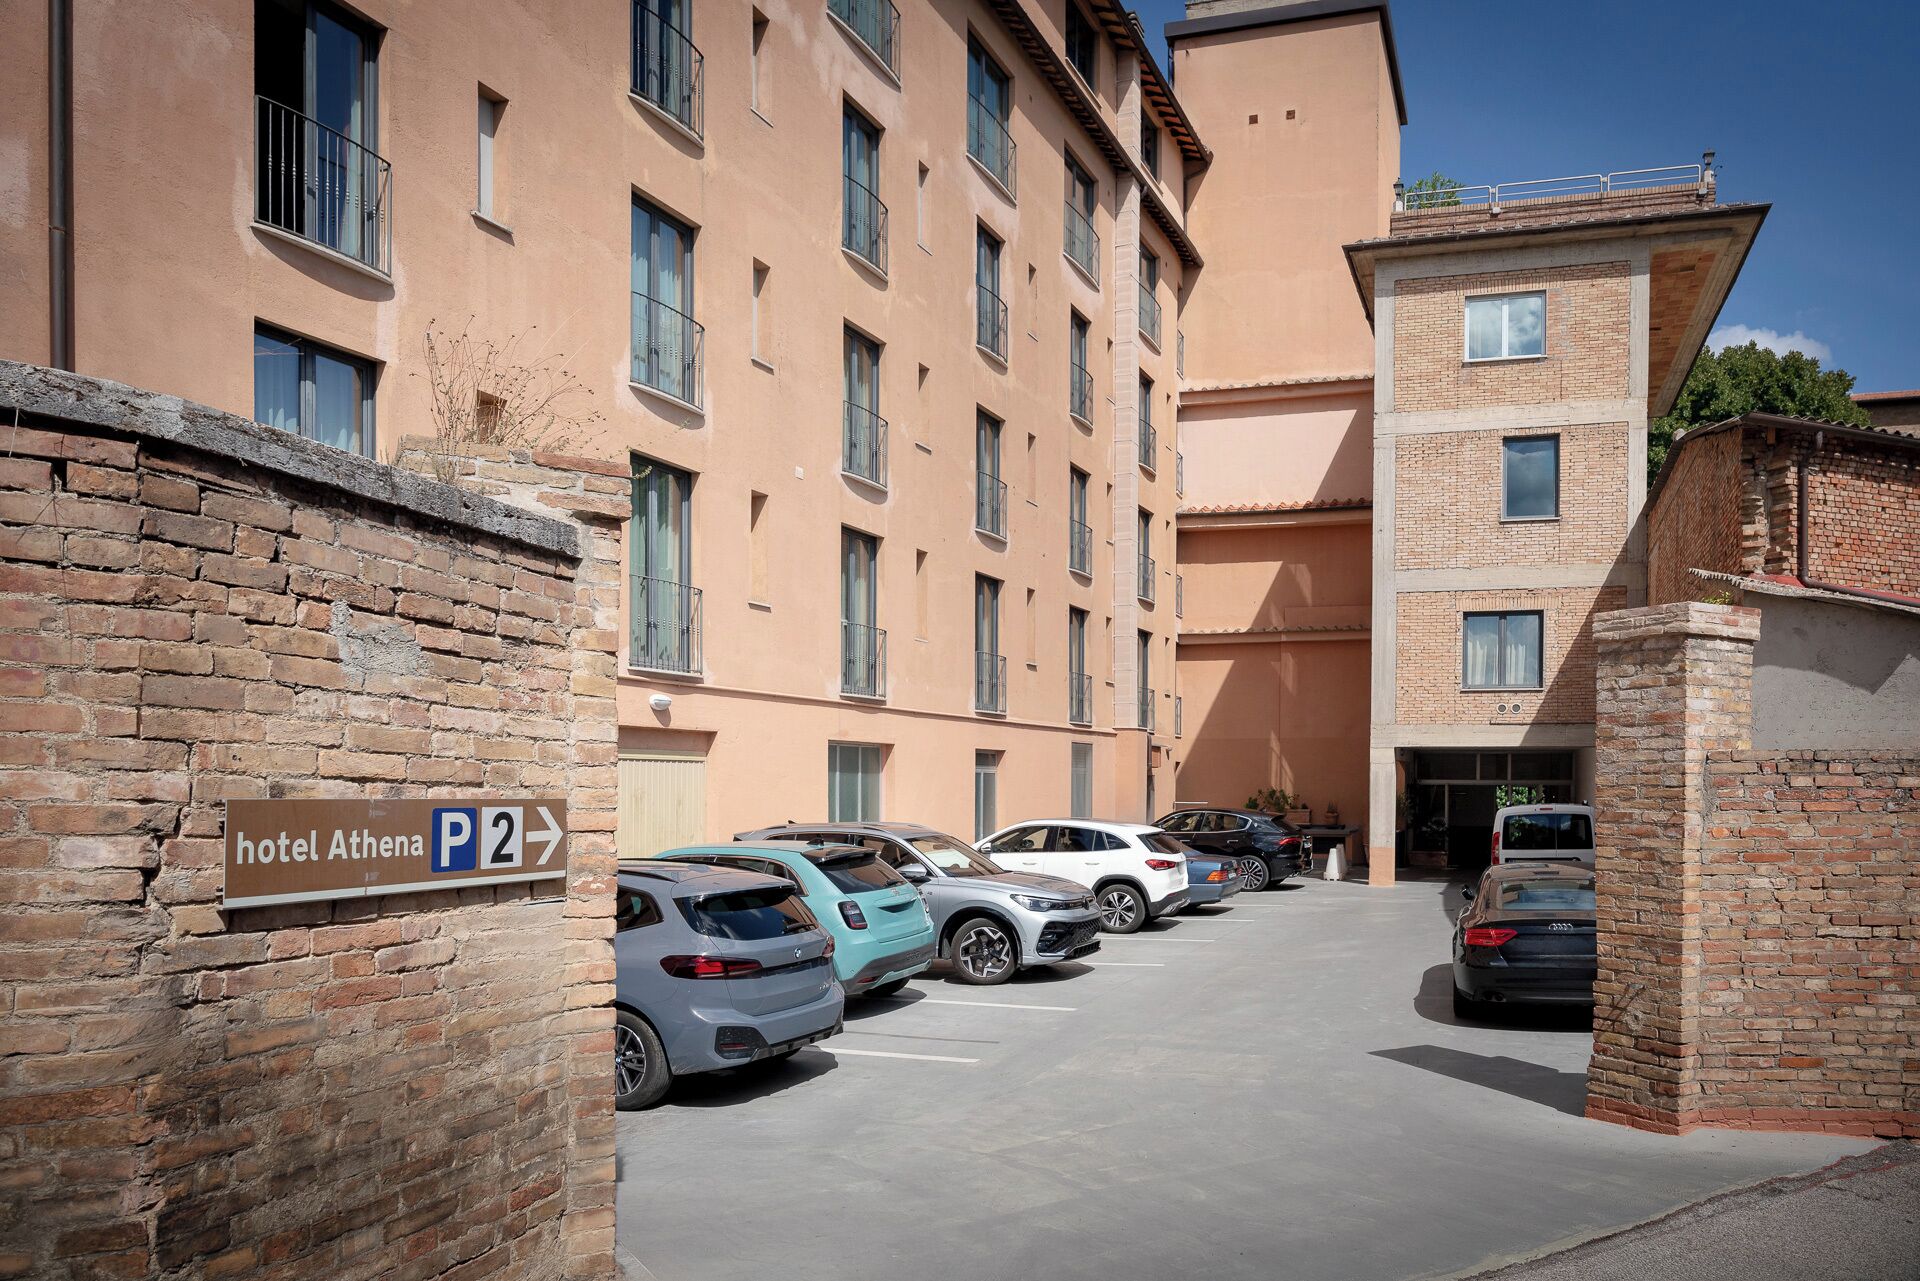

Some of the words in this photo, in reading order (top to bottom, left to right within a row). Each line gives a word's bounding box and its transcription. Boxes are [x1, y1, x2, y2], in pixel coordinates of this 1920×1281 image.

[236, 830, 319, 865] hotel
[327, 828, 425, 860] Athena
[440, 812, 472, 867] P
[490, 811, 515, 864] 2
